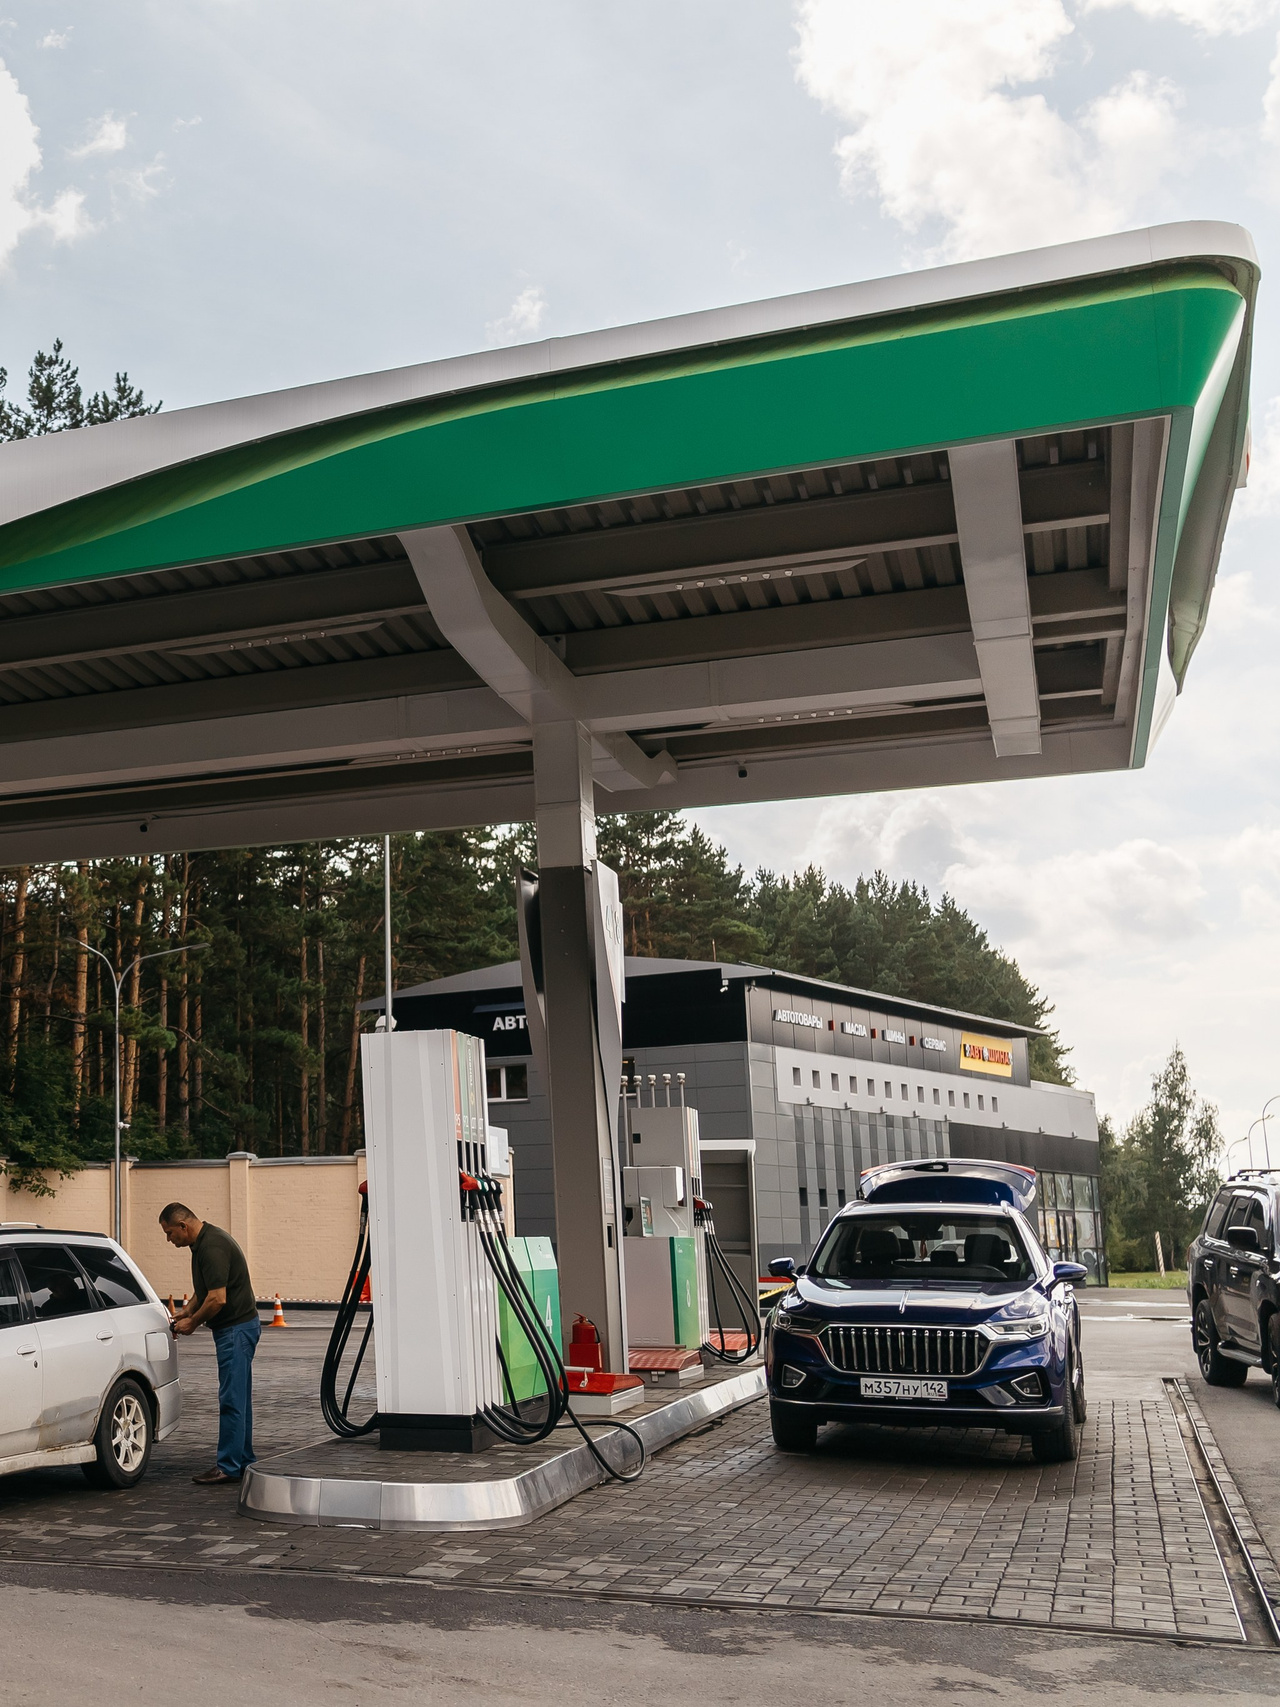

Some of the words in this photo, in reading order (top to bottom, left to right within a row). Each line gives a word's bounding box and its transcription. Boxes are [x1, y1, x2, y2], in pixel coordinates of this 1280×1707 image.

[492, 1015, 528, 1031] АВТ
[775, 1008, 823, 1029] АВТОТОВАРЫ
[843, 1021, 868, 1038] МАСЛА
[884, 1029, 906, 1045] ШИНЫ
[923, 1037, 947, 1052] СЕРВИС
[685, 1279, 691, 1308] 8
[545, 1294, 553, 1334] 4
[864, 1381, 920, 1396] М357НУ
[923, 1382, 944, 1393] 142
